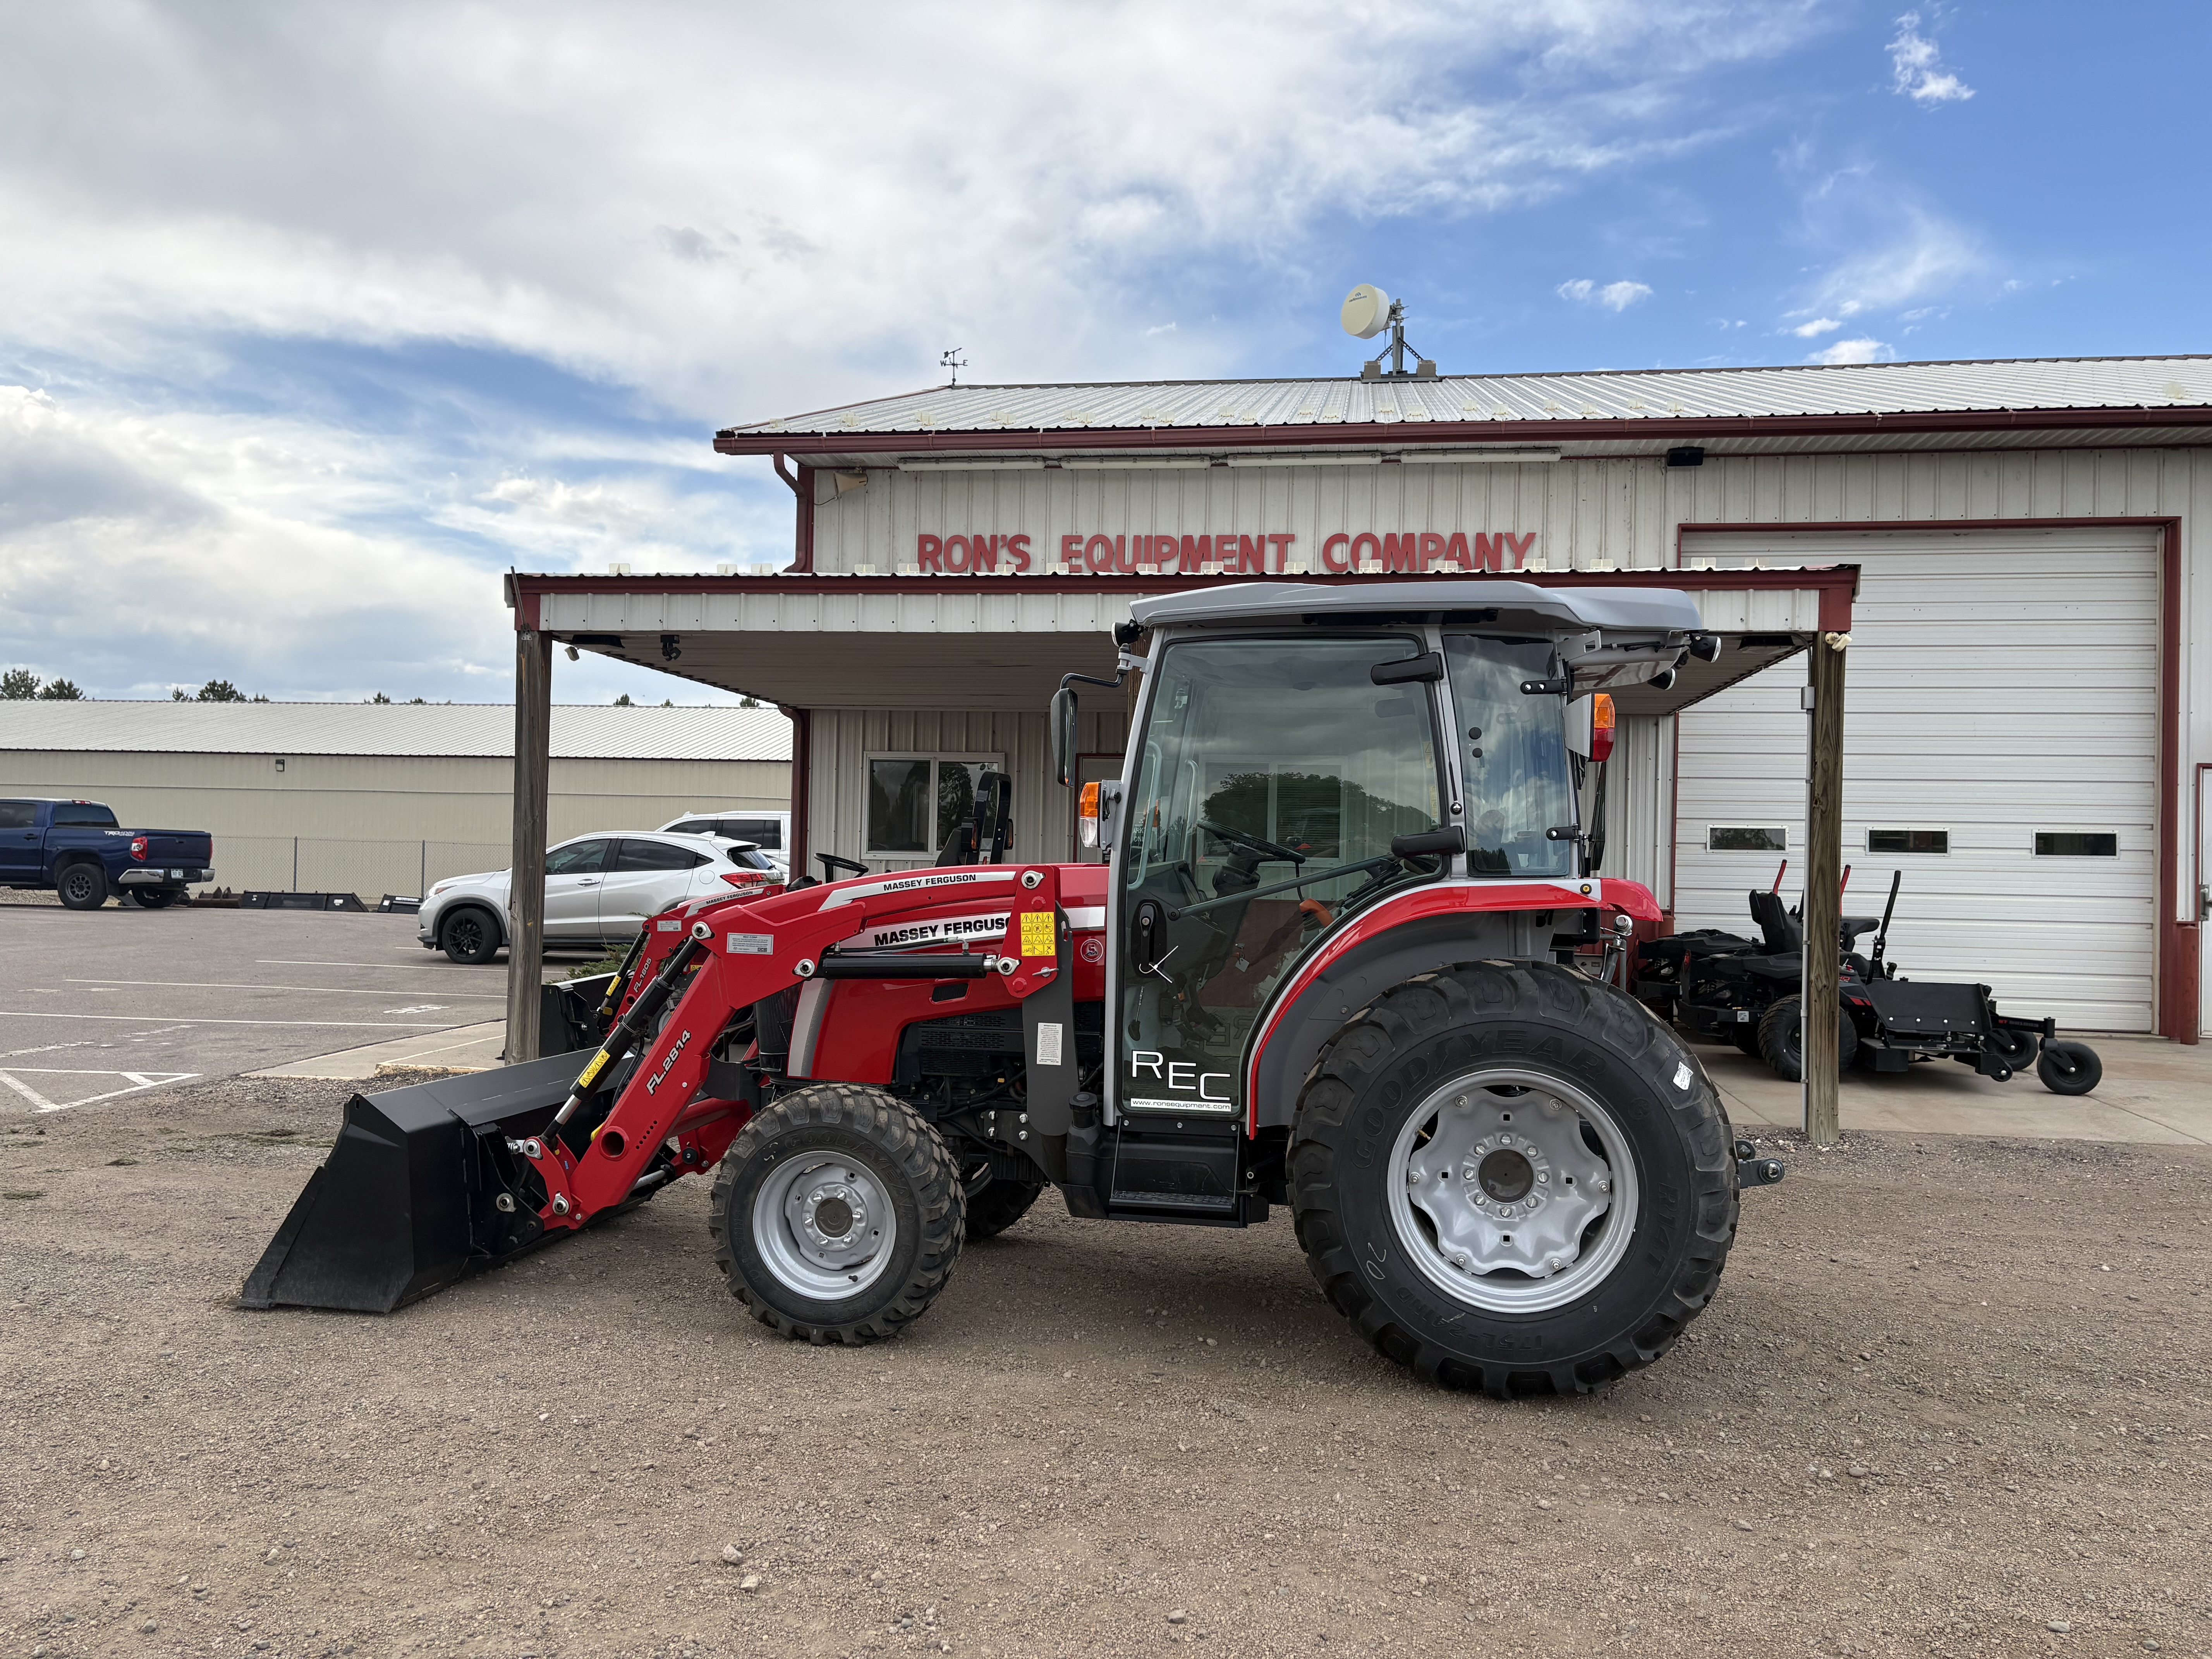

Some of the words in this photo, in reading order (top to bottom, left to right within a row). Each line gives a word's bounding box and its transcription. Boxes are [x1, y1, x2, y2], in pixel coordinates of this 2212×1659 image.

[918, 534, 1030, 572] RON'S
[1061, 534, 1295, 573] EQUIPMENT
[1322, 532, 1537, 572] COMPANY
[706, 896, 726, 905] MASSEY
[727, 891, 753, 899] FERGUSON
[883, 879, 922, 891] MASSEY
[926, 874, 976, 885] FERGUSON
[874, 925, 939, 946] MASSEY
[944, 917, 1010, 936] FERGUS
[646, 1029, 691, 1096] FL.2814
[1132, 1050, 1231, 1101] REC
[1132, 1100, 1230, 1110] www.ronsequipment.com
[1352, 1030, 1607, 1169] GOODYEAR
[785, 1130, 916, 1224] GOODYEAR
